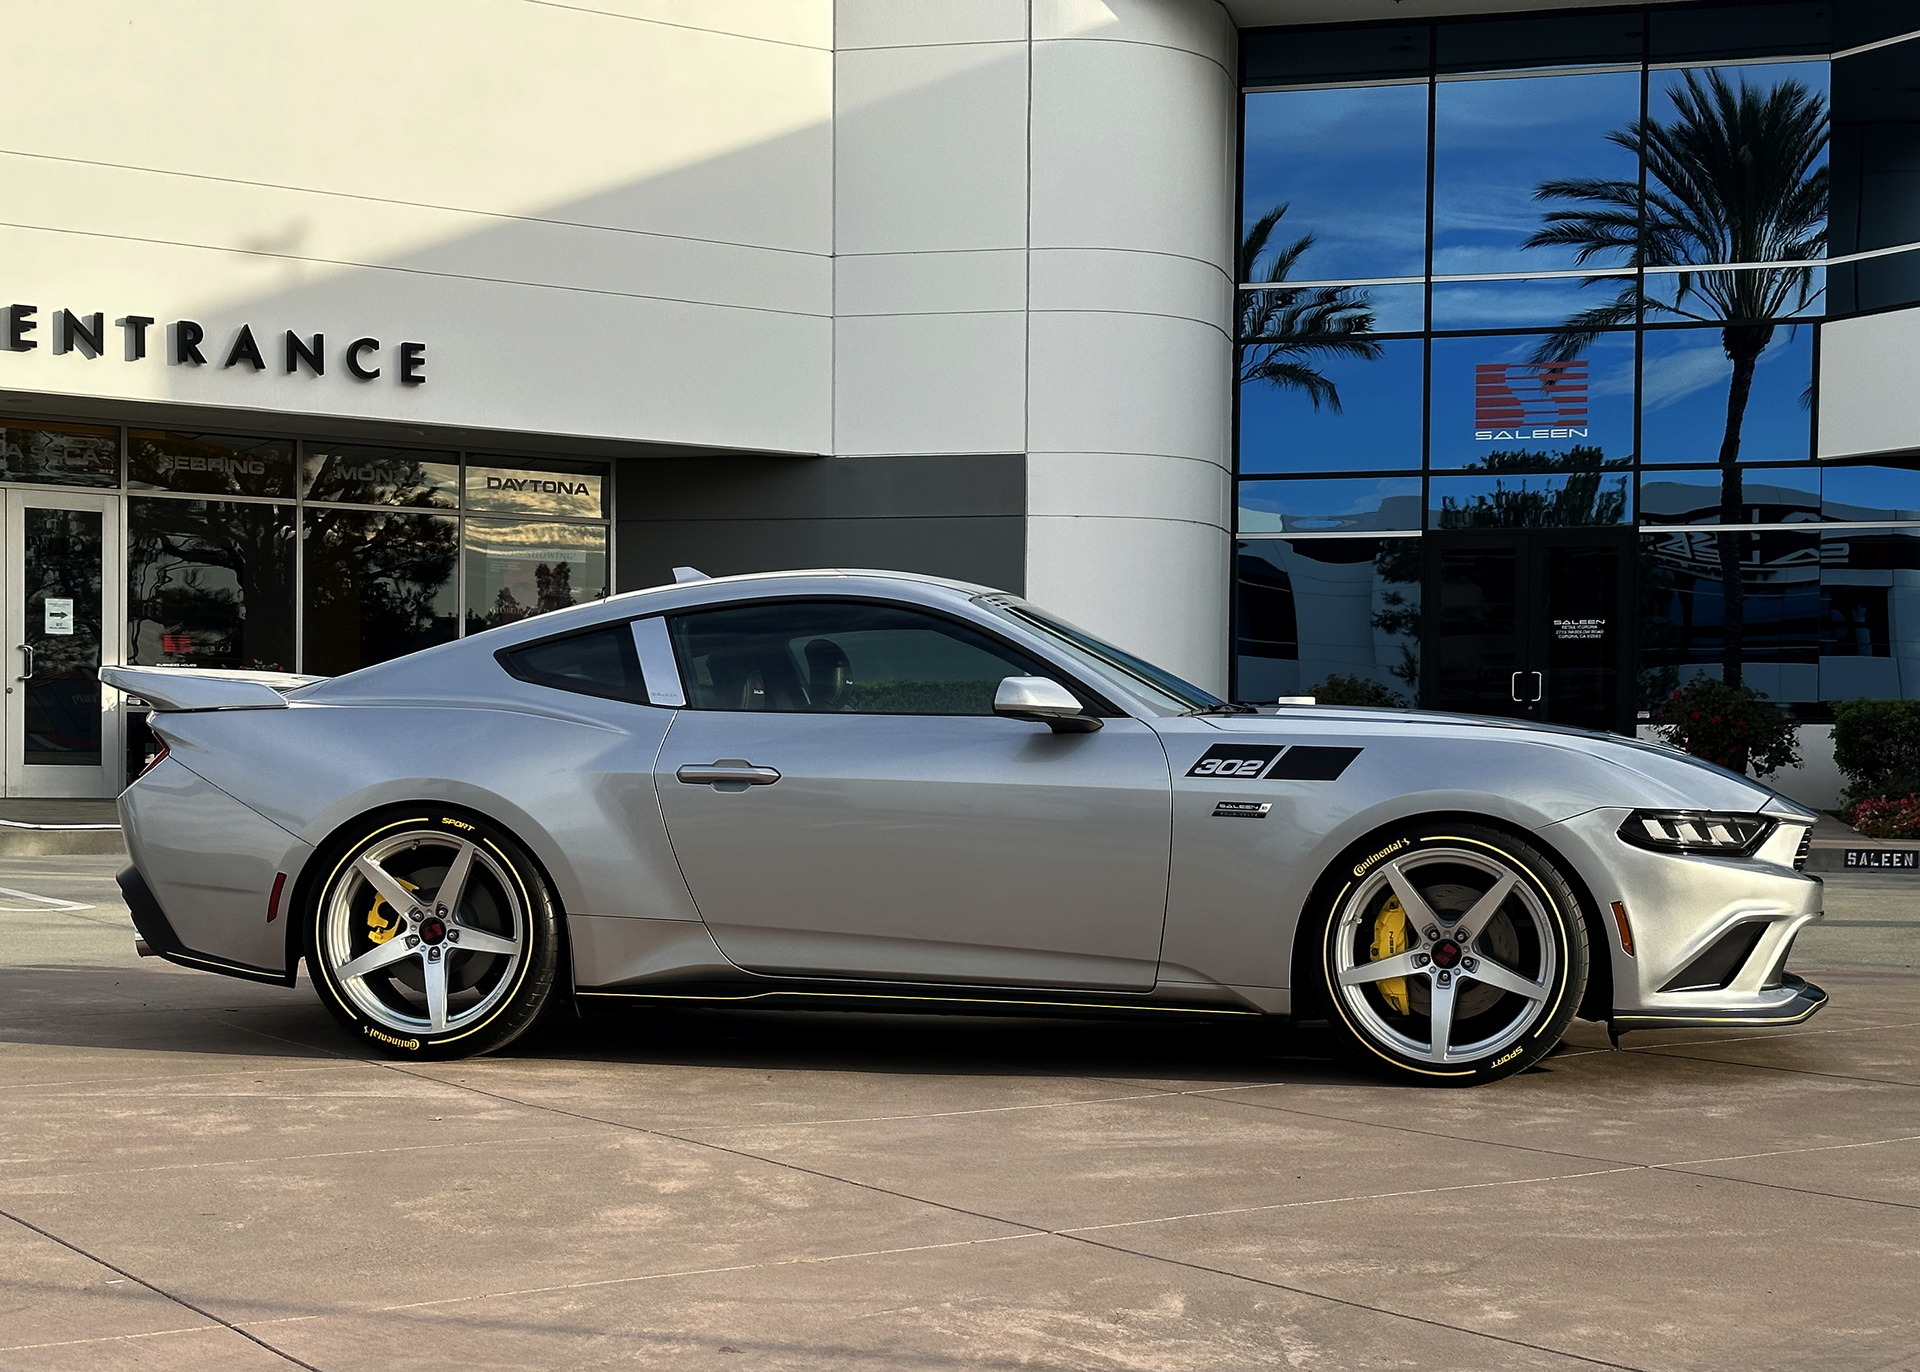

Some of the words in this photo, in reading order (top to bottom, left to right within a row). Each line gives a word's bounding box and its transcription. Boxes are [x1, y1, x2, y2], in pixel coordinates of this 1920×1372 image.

[8, 303, 427, 385] ENTRANCE
[1474, 428, 1588, 441] SALEEN
[158, 455, 266, 476] SEBRING
[486, 476, 590, 496] DAYTONA
[1194, 758, 1265, 776] 302
[1219, 803, 1259, 811] SALEEN
[441, 817, 476, 832] SPORT
[1353, 839, 1403, 877] Continental
[1846, 852, 1914, 867] SALEEN
[369, 1027, 420, 1051] Continental
[1490, 1045, 1523, 1069] SPORT
